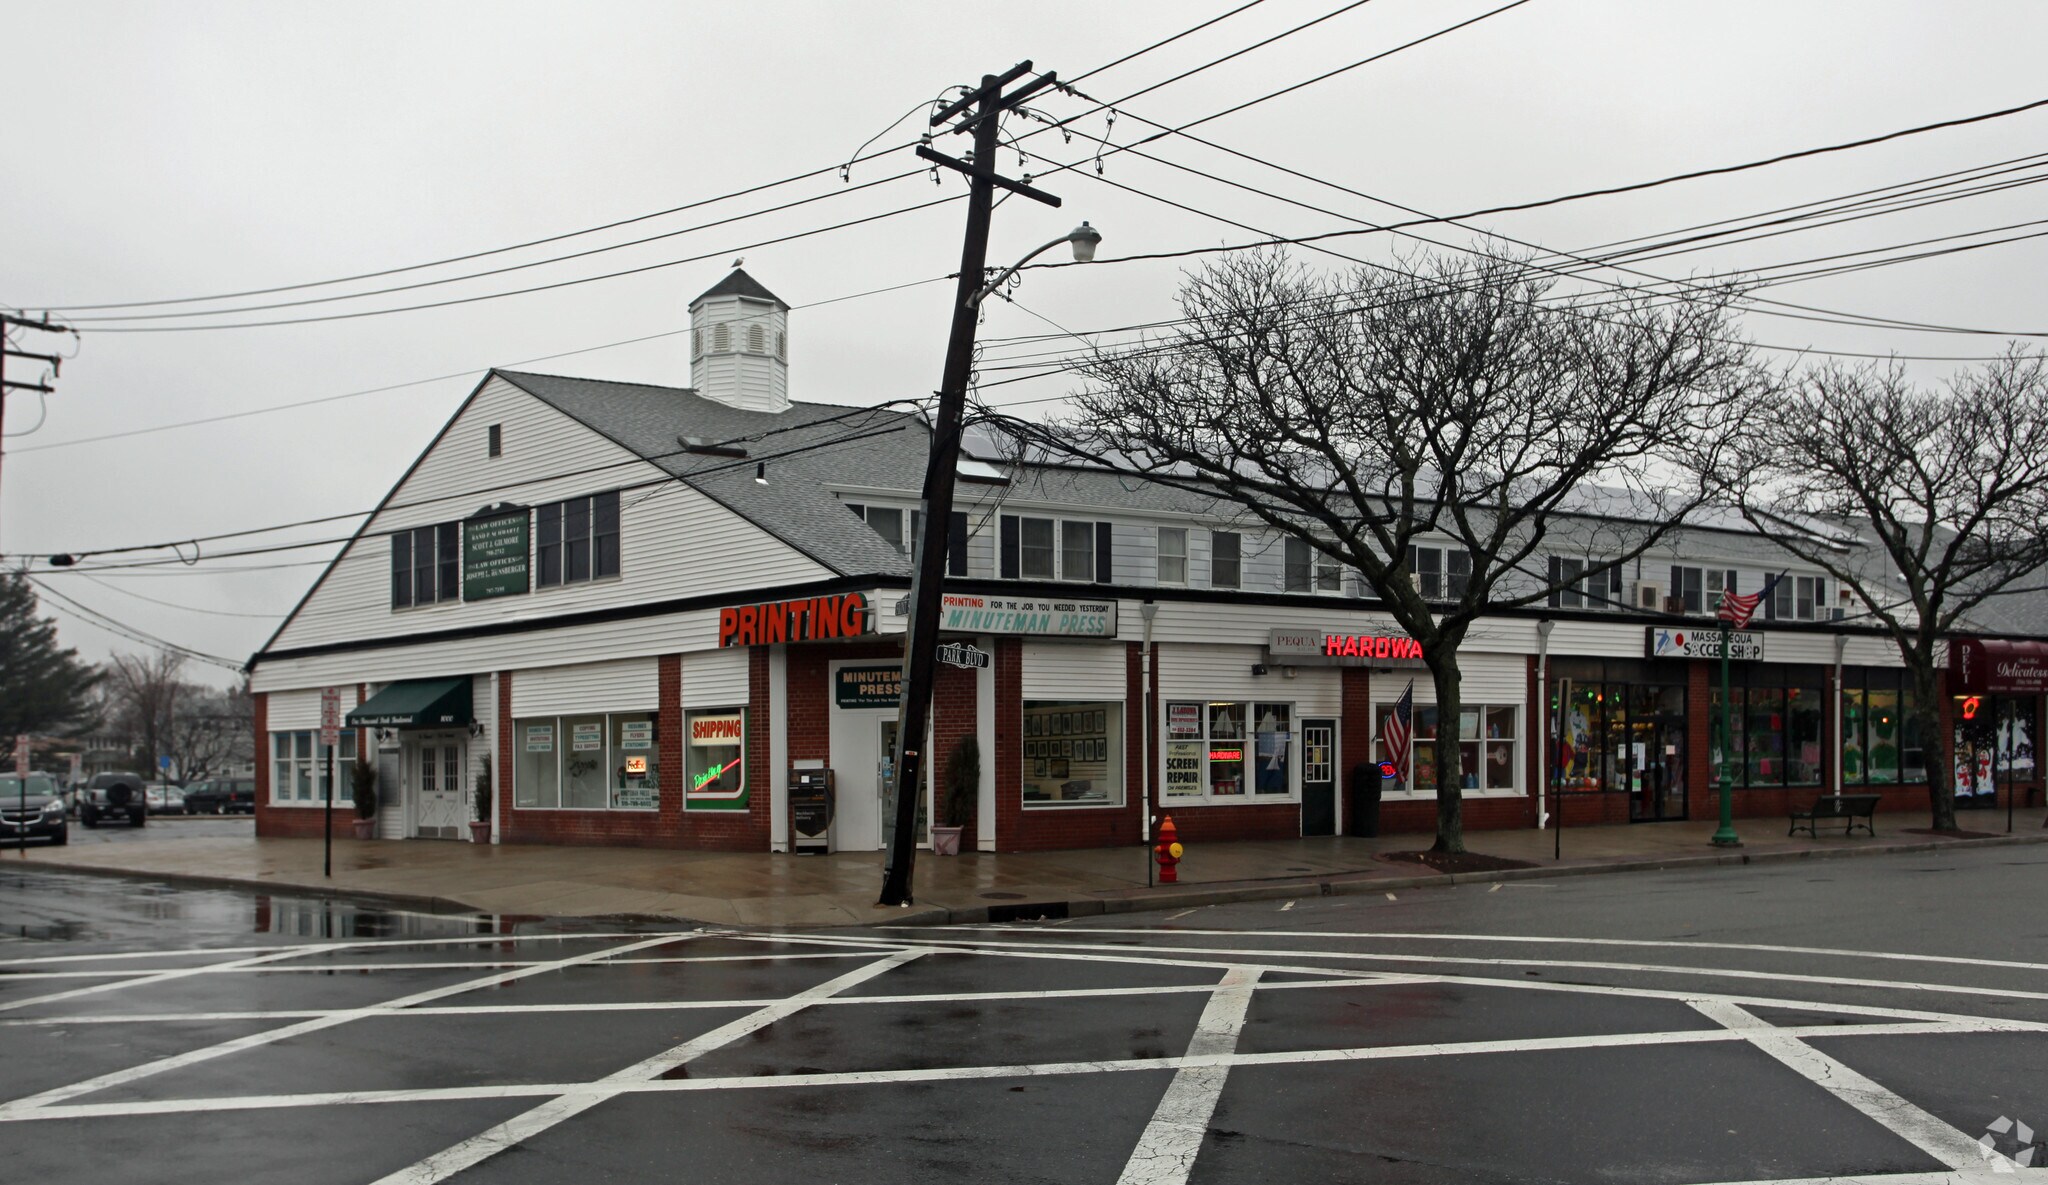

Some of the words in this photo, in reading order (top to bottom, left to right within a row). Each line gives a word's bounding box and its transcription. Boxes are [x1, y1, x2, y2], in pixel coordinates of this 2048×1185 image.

[475, 522, 488, 531] LAW
[489, 518, 515, 528] OFFICES
[472, 541, 488, 551] SCOTT
[494, 536, 519, 547] GILMORE
[475, 561, 488, 569] LAW
[489, 557, 515, 567] OFFICES
[466, 571, 485, 581] JOSEPH
[943, 596, 984, 608] PRINTING
[990, 600, 1003, 609] FOR
[1006, 601, 1017, 610] THE
[1021, 602, 1034, 611] JOB
[1038, 602, 1050, 611] YOU
[1053, 603, 1076, 612] NEEDED
[1079, 604, 1109, 613] YESTERDAY
[719, 592, 867, 648] PRINTING
[947, 609, 1050, 633] MINUTEMAN
[1059, 614, 1106, 633] PRESS
[1691, 631, 1752, 644] MASSAEQUA
[1277, 636, 1315, 647] PEQUA
[1326, 635, 1423, 659] HARDWA
[1683, 642, 1722, 657] SOCCE
[1731, 645, 1760, 659] SHOP
[942, 647, 961, 663] PARK
[965, 651, 983, 667] BLVD
[843, 671, 901, 683] MINUTEM
[859, 683, 901, 695] PRESS
[692, 719, 741, 739] SHIPPING
[1208, 751, 1241, 760] HARDWARE
[627, 760, 645, 769] FedEx
[1166, 758, 1198, 770] SCREEN
[1167, 771, 1198, 783] REPAIR
